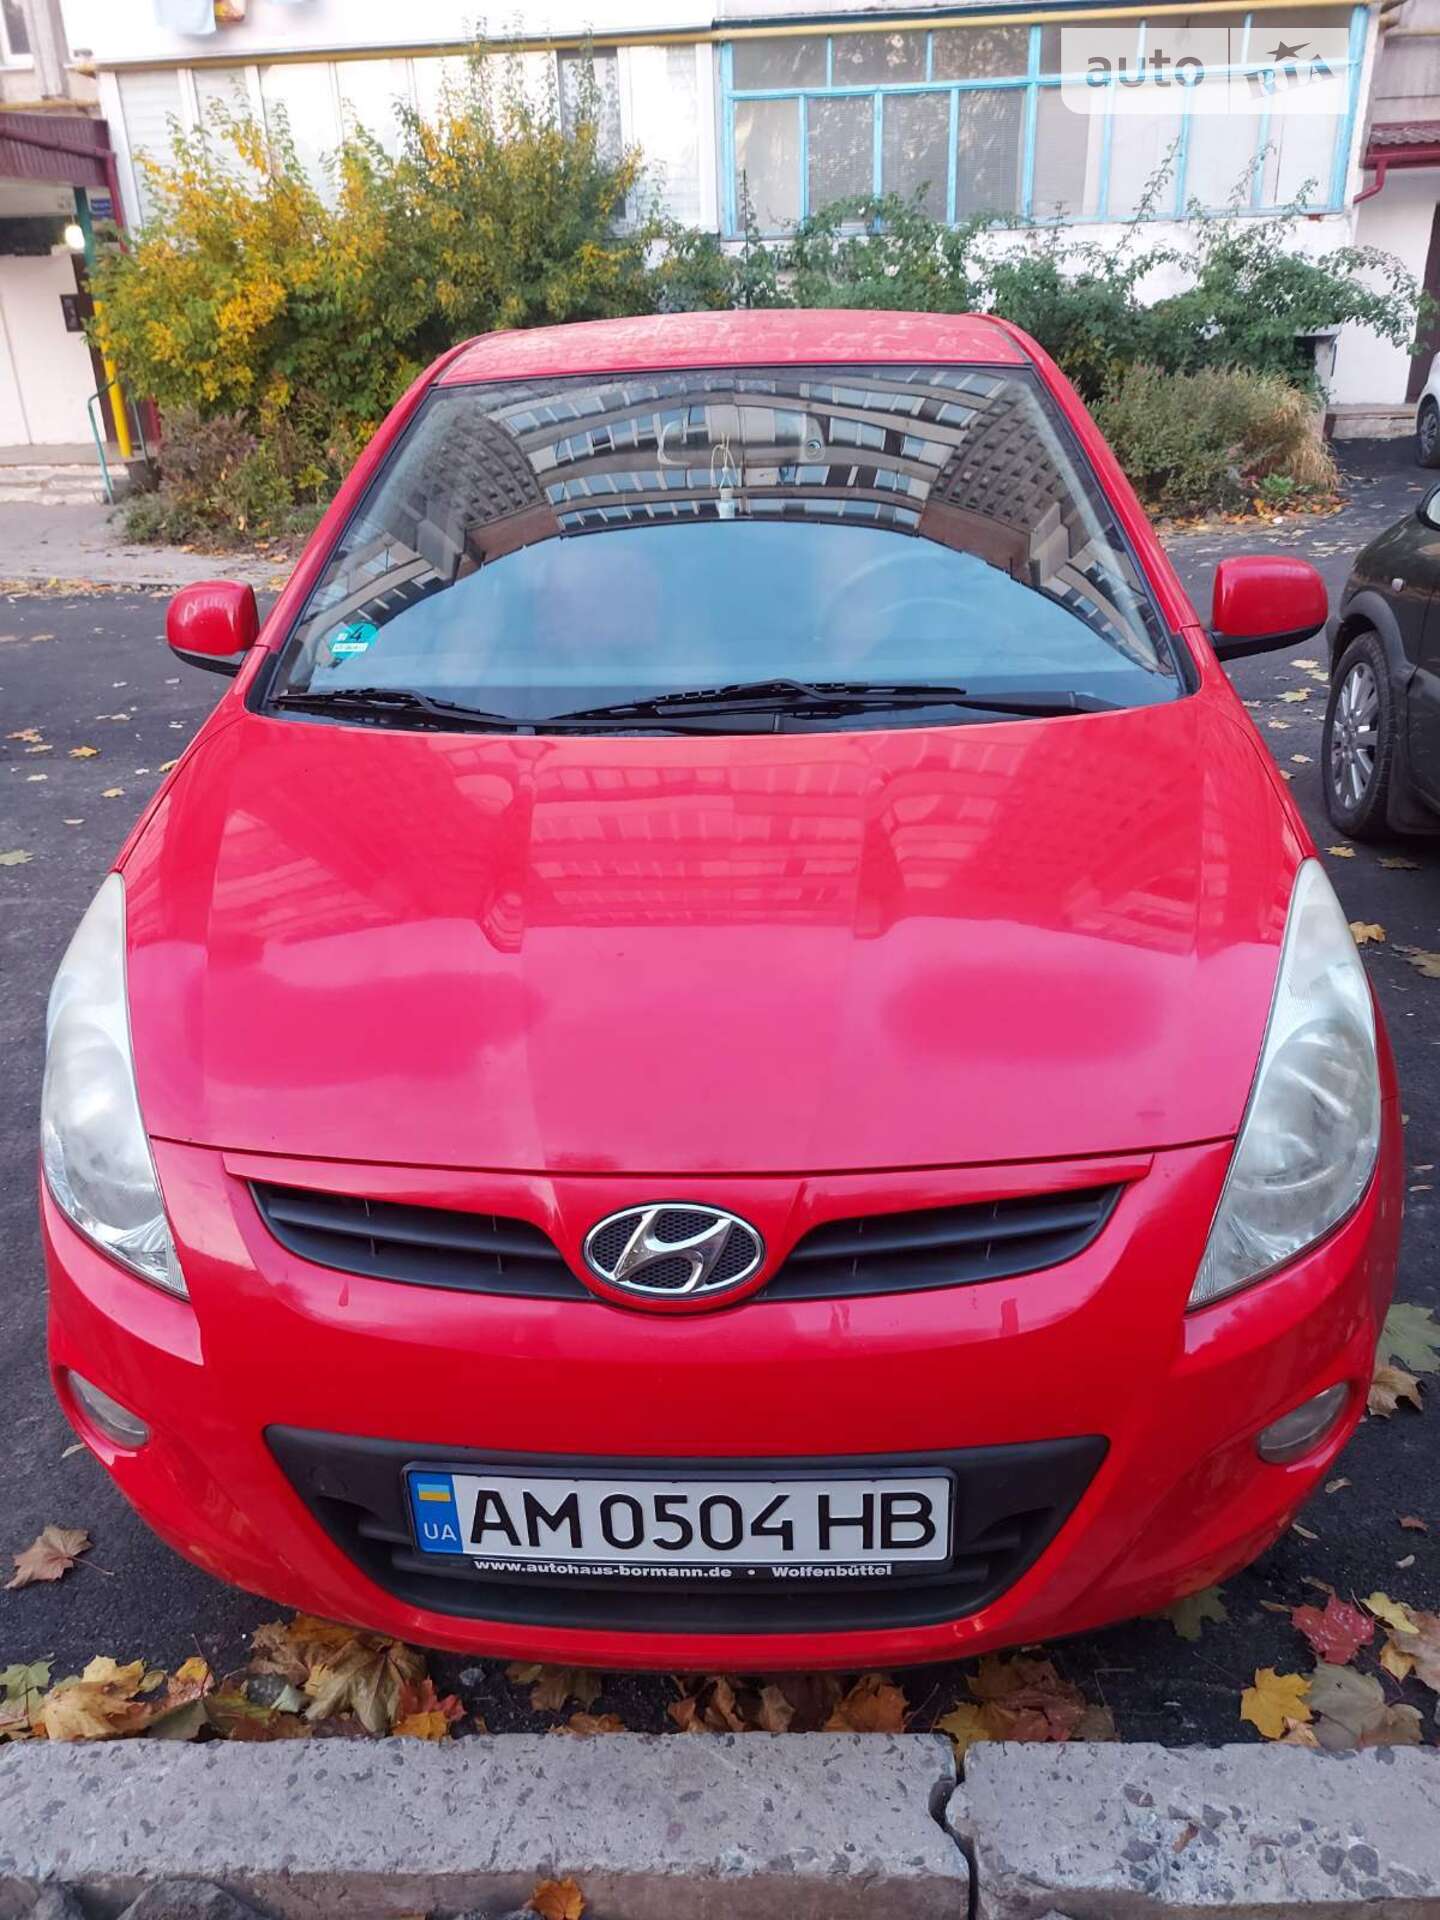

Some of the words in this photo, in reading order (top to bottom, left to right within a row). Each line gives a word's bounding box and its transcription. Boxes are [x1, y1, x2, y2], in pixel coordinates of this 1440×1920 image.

[350, 624, 364, 641] 4
[470, 1489, 583, 1549] AM
[600, 1493, 795, 1551] 0504
[818, 1492, 937, 1550] HB
[423, 1522, 457, 1541] UA
[474, 1559, 732, 1578] www.autohaus-bormann.de
[771, 1563, 892, 1578] Wolfenbüttel
